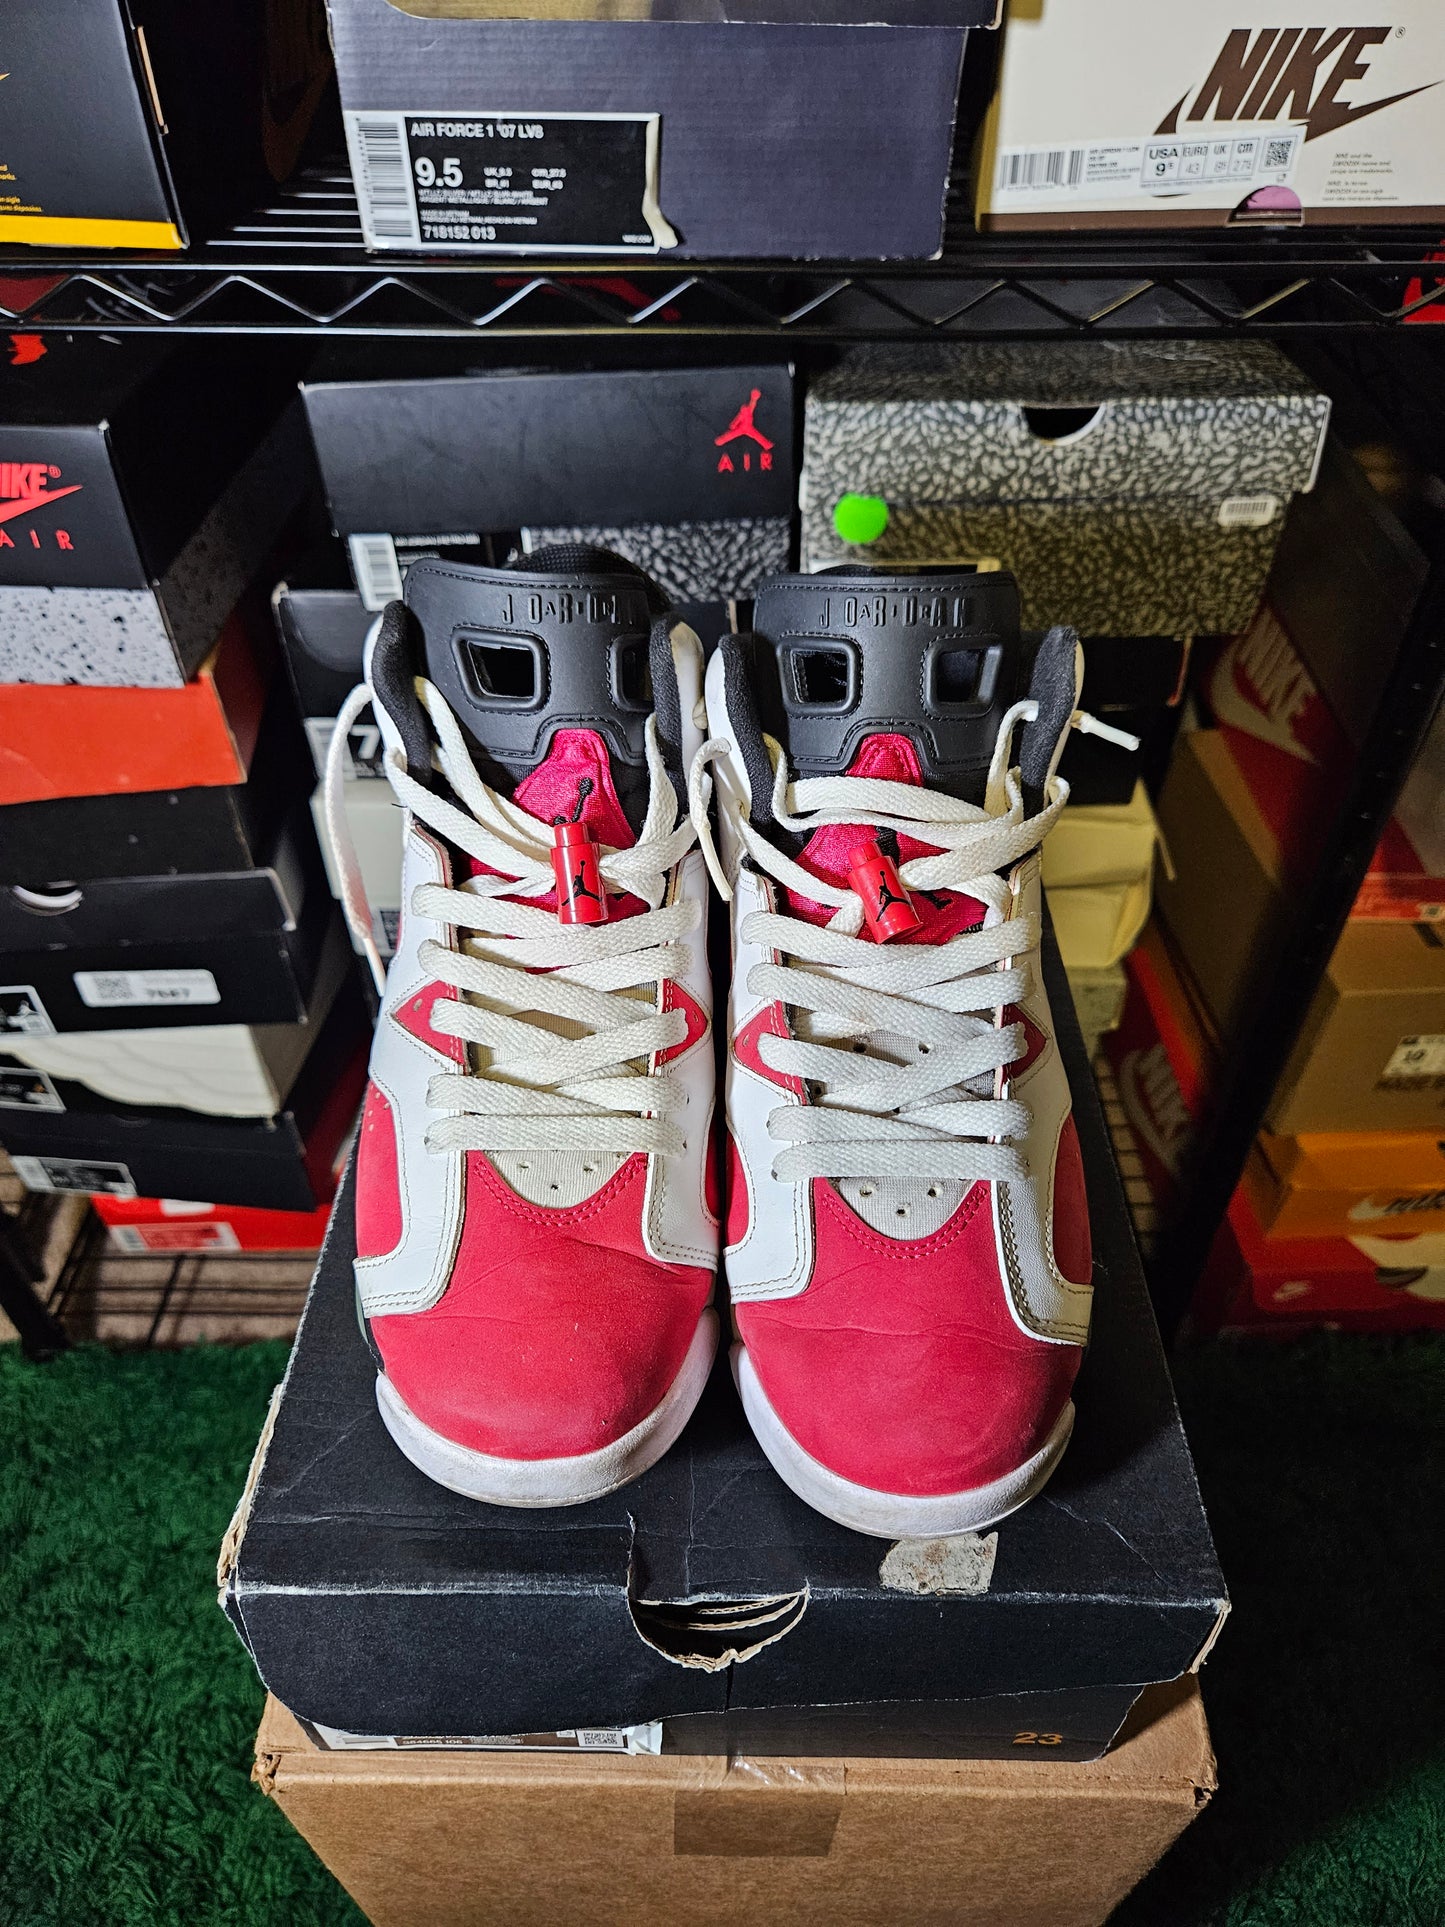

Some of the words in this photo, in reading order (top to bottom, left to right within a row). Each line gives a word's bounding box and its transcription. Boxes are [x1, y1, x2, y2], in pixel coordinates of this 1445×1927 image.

[1186, 27, 1392, 121] NIKE
[411, 122, 435, 137] AIR
[436, 123, 485, 138] FORCE
[485, 124, 494, 138] 1
[496, 124, 516, 139] '07
[518, 124, 544, 139] LV8
[1149, 147, 1178, 160] USA
[415, 157, 463, 188] 9.5
[422, 225, 470, 240] 718152
[717, 451, 772, 472] AIR
[0, 462, 48, 499] IKE
[1012, 1731, 1063, 1745] 23
